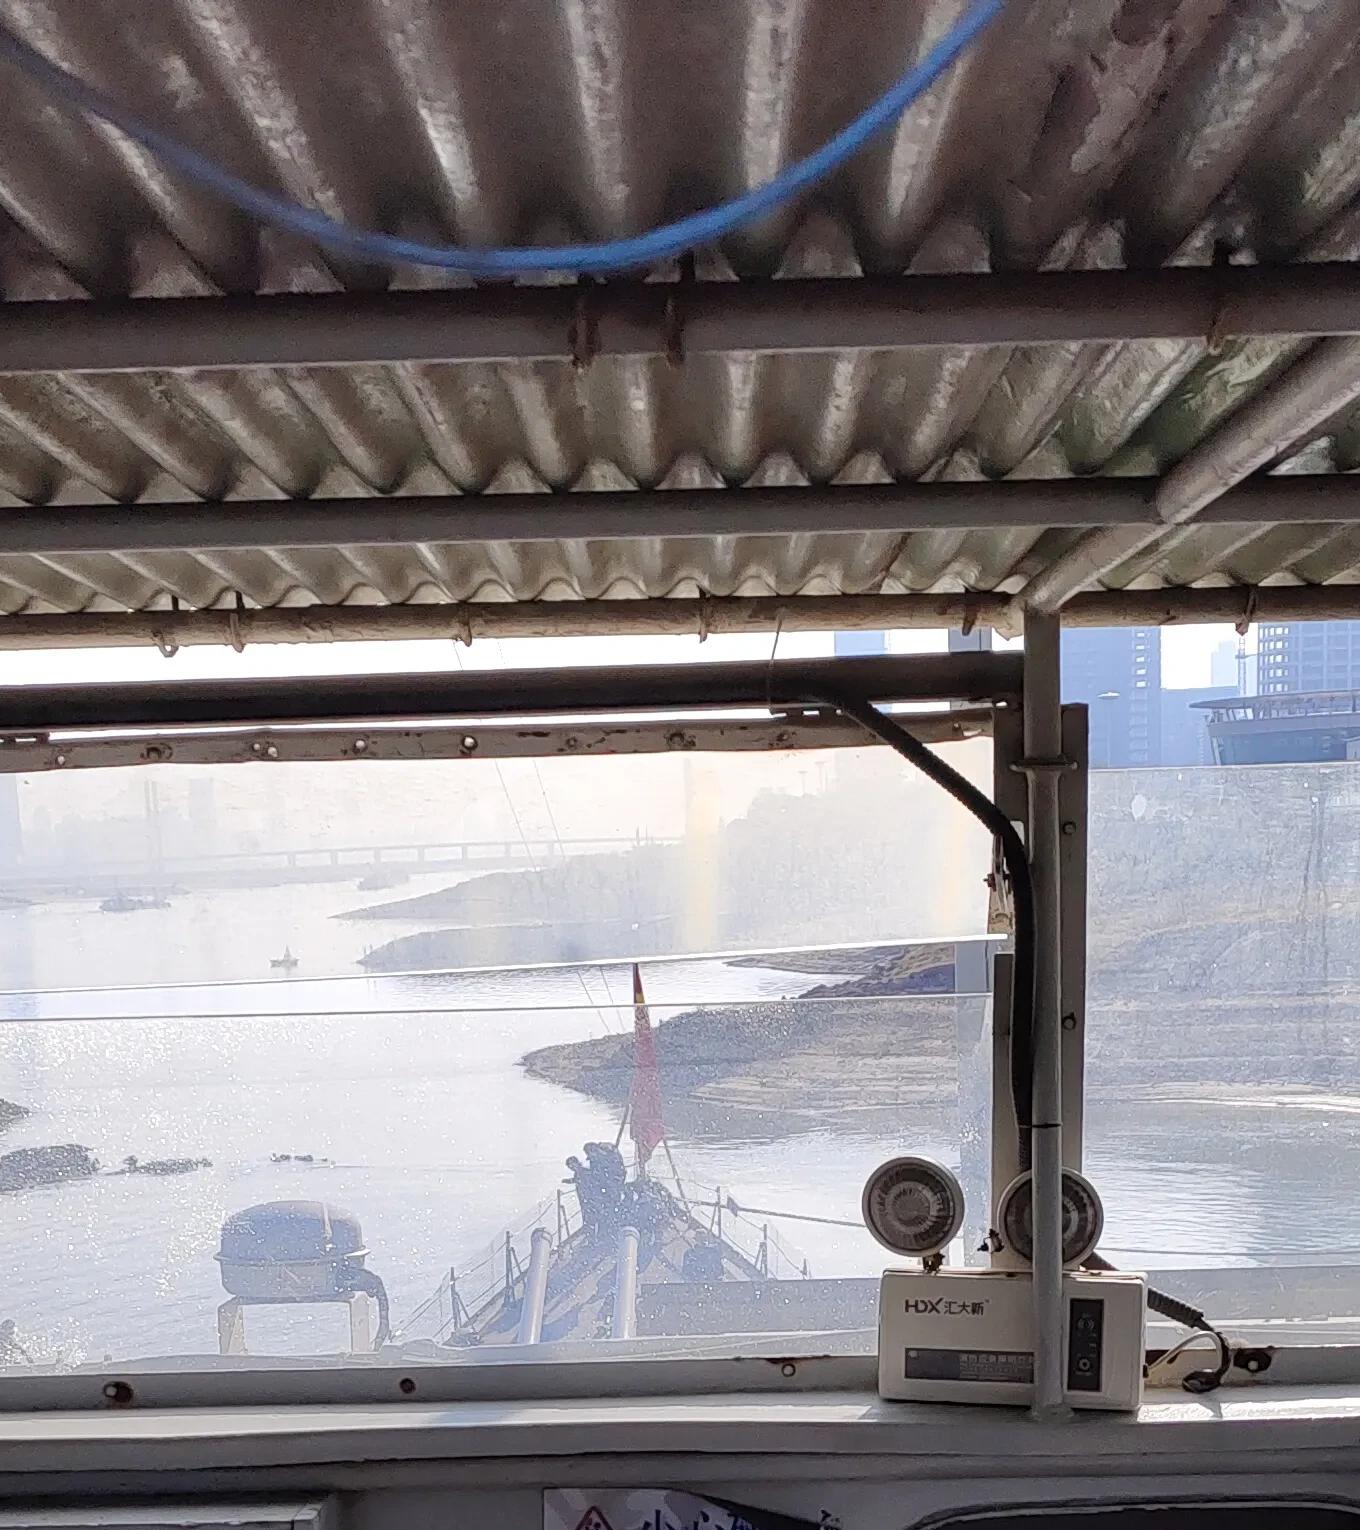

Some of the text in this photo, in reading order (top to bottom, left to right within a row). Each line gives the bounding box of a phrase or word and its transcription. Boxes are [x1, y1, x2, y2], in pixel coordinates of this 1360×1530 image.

[904, 1297, 984, 1316] HDX 汇大新
